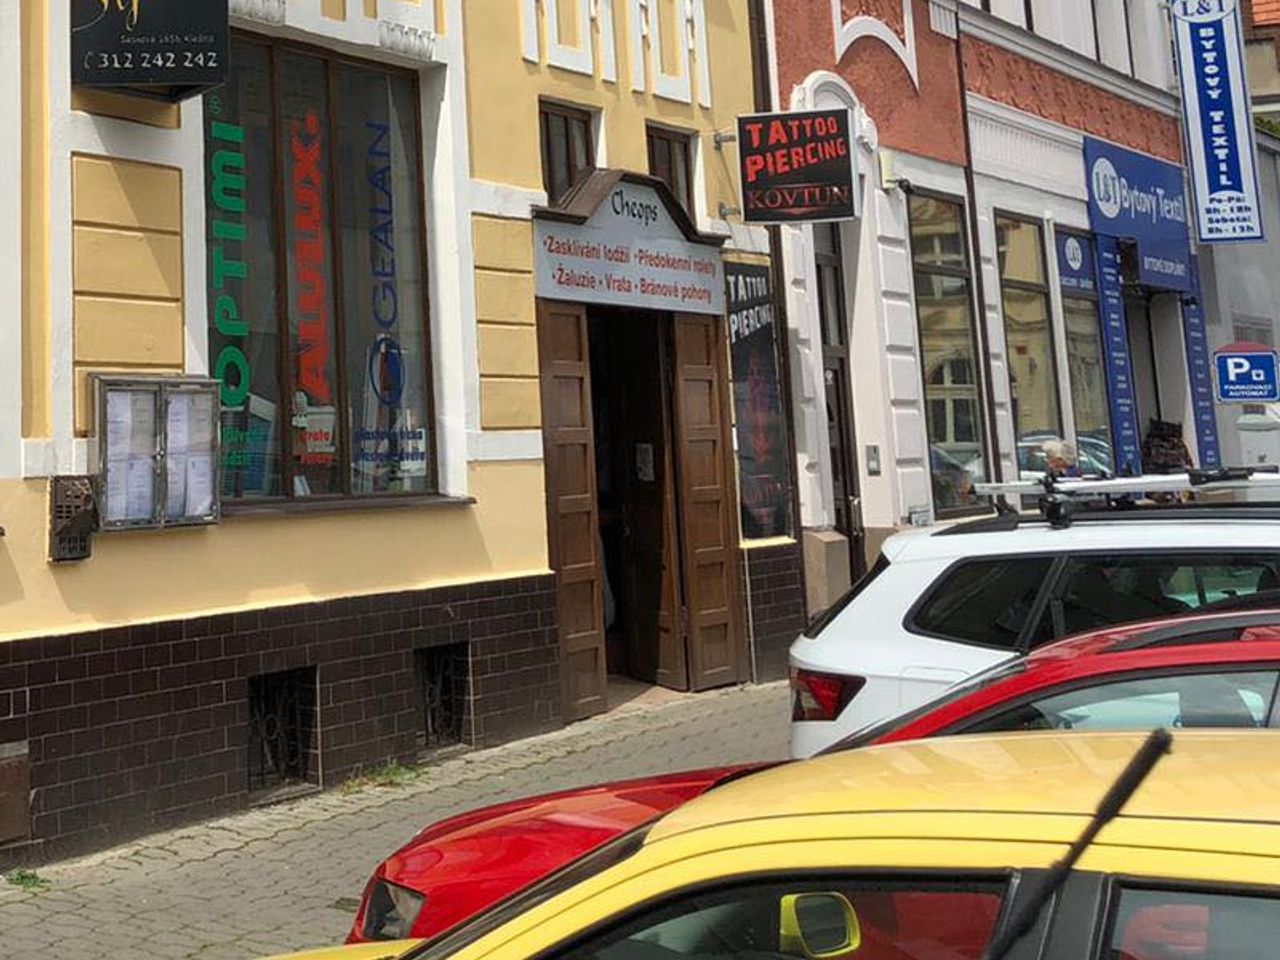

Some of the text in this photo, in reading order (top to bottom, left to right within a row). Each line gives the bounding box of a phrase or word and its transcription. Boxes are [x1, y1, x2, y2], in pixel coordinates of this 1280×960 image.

[99, 51, 218, 68] 312 242 242
[746, 117, 838, 149] TATTOO
[1209, 110, 1233, 186] TEXTIL
[746, 138, 847, 182] PIERCING
[747, 185, 850, 208] KOVTUN
[1120, 177, 1156, 224] Bytový
[1157, 188, 1186, 224] Textil
[365, 119, 399, 330] GEALAN
[211, 122, 250, 409] OPTIMI
[1226, 357, 1250, 381] P
